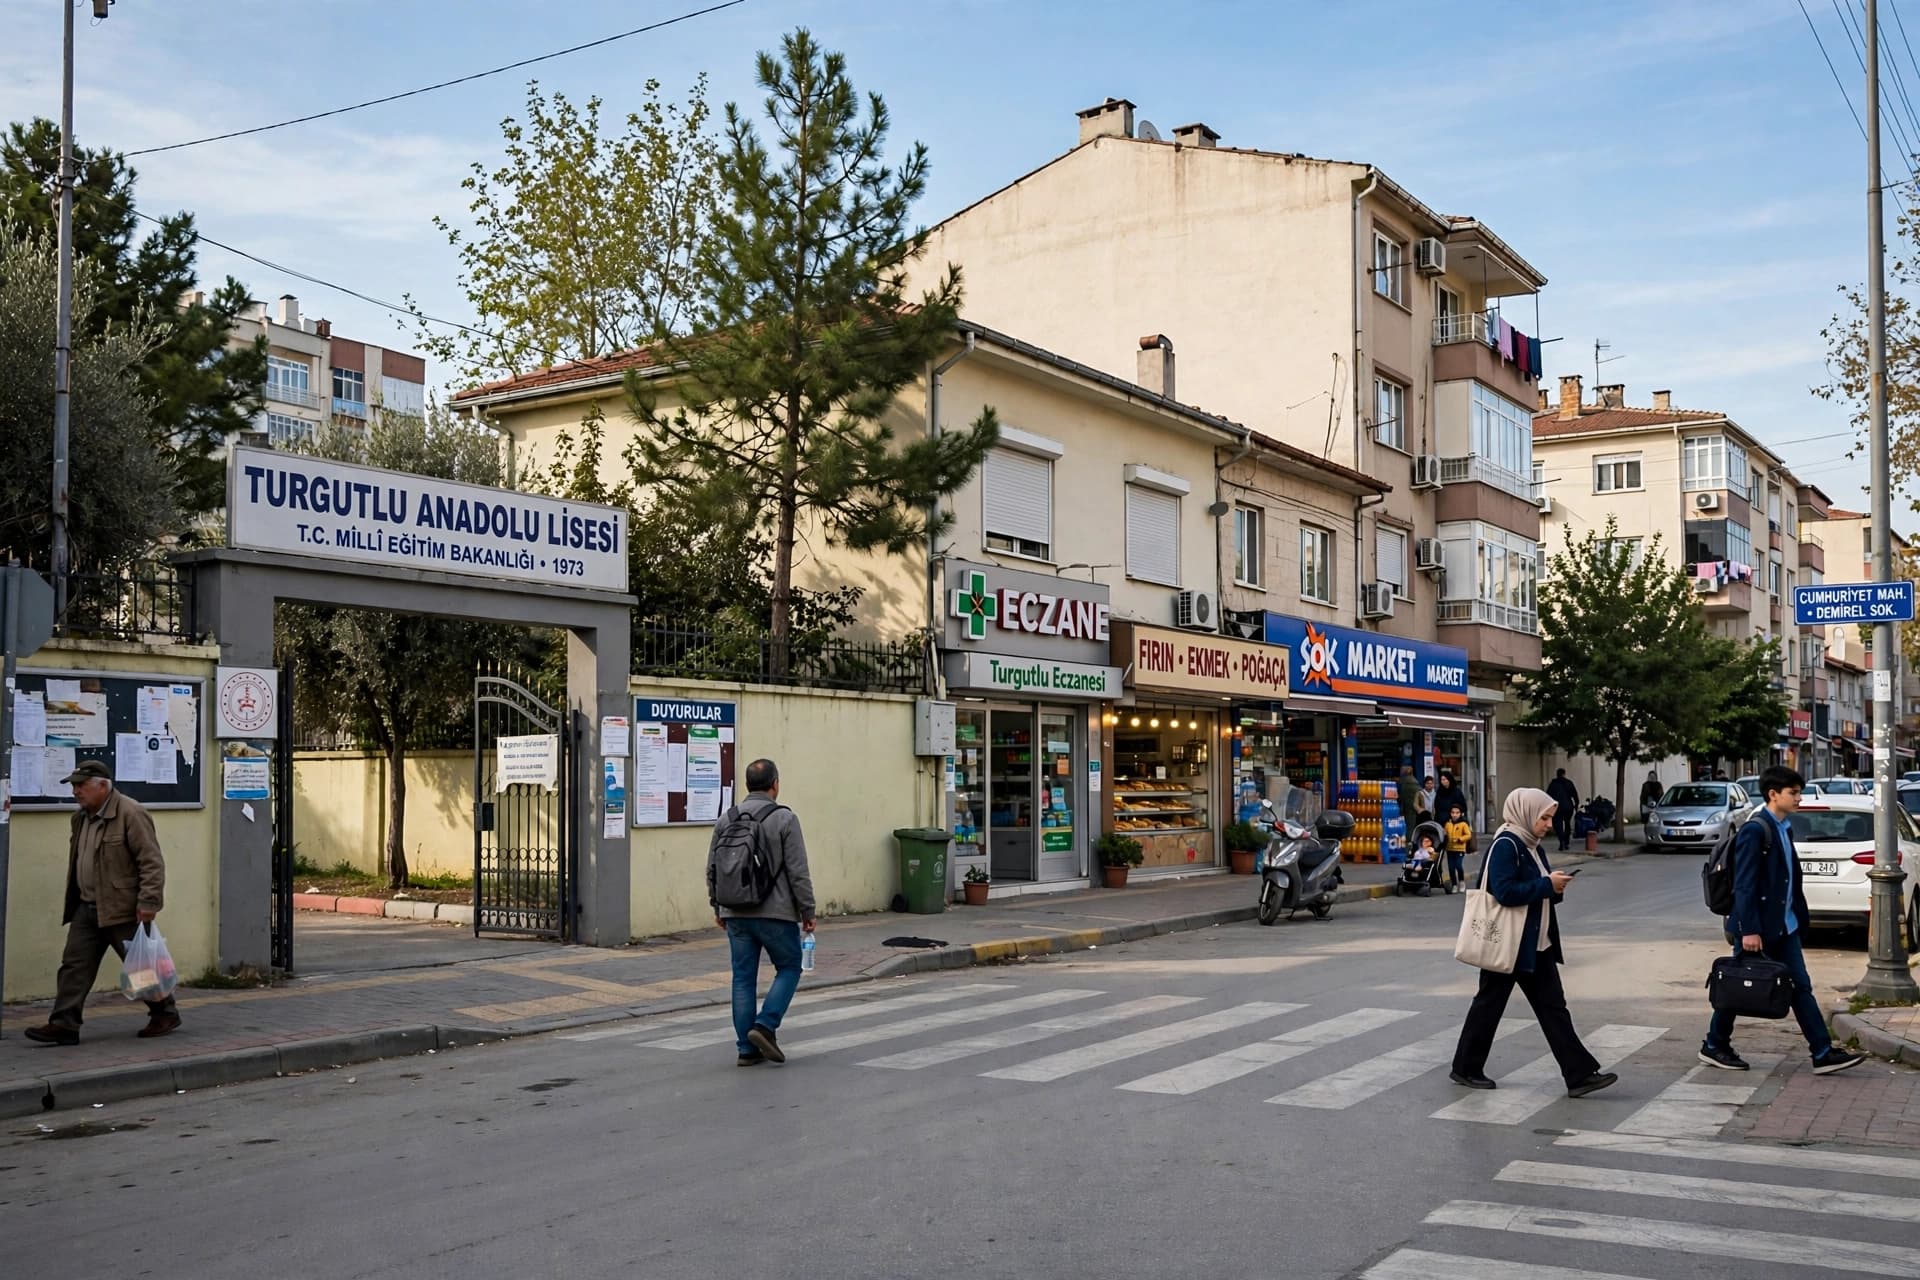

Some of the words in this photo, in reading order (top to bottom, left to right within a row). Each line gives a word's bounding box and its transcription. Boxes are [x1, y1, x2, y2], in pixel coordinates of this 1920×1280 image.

[245, 466, 407, 525] TURGUTLU
[416, 494, 540, 543] ANADOLU
[548, 507, 619, 554] LİSESİ
[297, 524, 330, 546] T.C.
[388, 533, 445, 560] EĞİTİM
[450, 545, 535, 570] BAKANLIĞI
[552, 558, 584, 576] 1973
[998, 588, 1110, 642] ECZANE
[1799, 587, 1873, 605] CUMHURİYET
[1877, 587, 1907, 601] MAH.
[1816, 603, 1866, 619] DEMİREL
[1869, 604, 1897, 616] SOK.
[990, 659, 1049, 690] Turgutlu
[1053, 667, 1105, 692] Eczanesi
[1139, 639, 1174, 673] FIRIN
[1187, 646, 1230, 679] EKMEK
[1241, 650, 1287, 692] POĞAÇA
[1347, 641, 1416, 684] MARKET
[1426, 664, 1465, 687] MARKET
[651, 703, 722, 721] DUYURULAR
